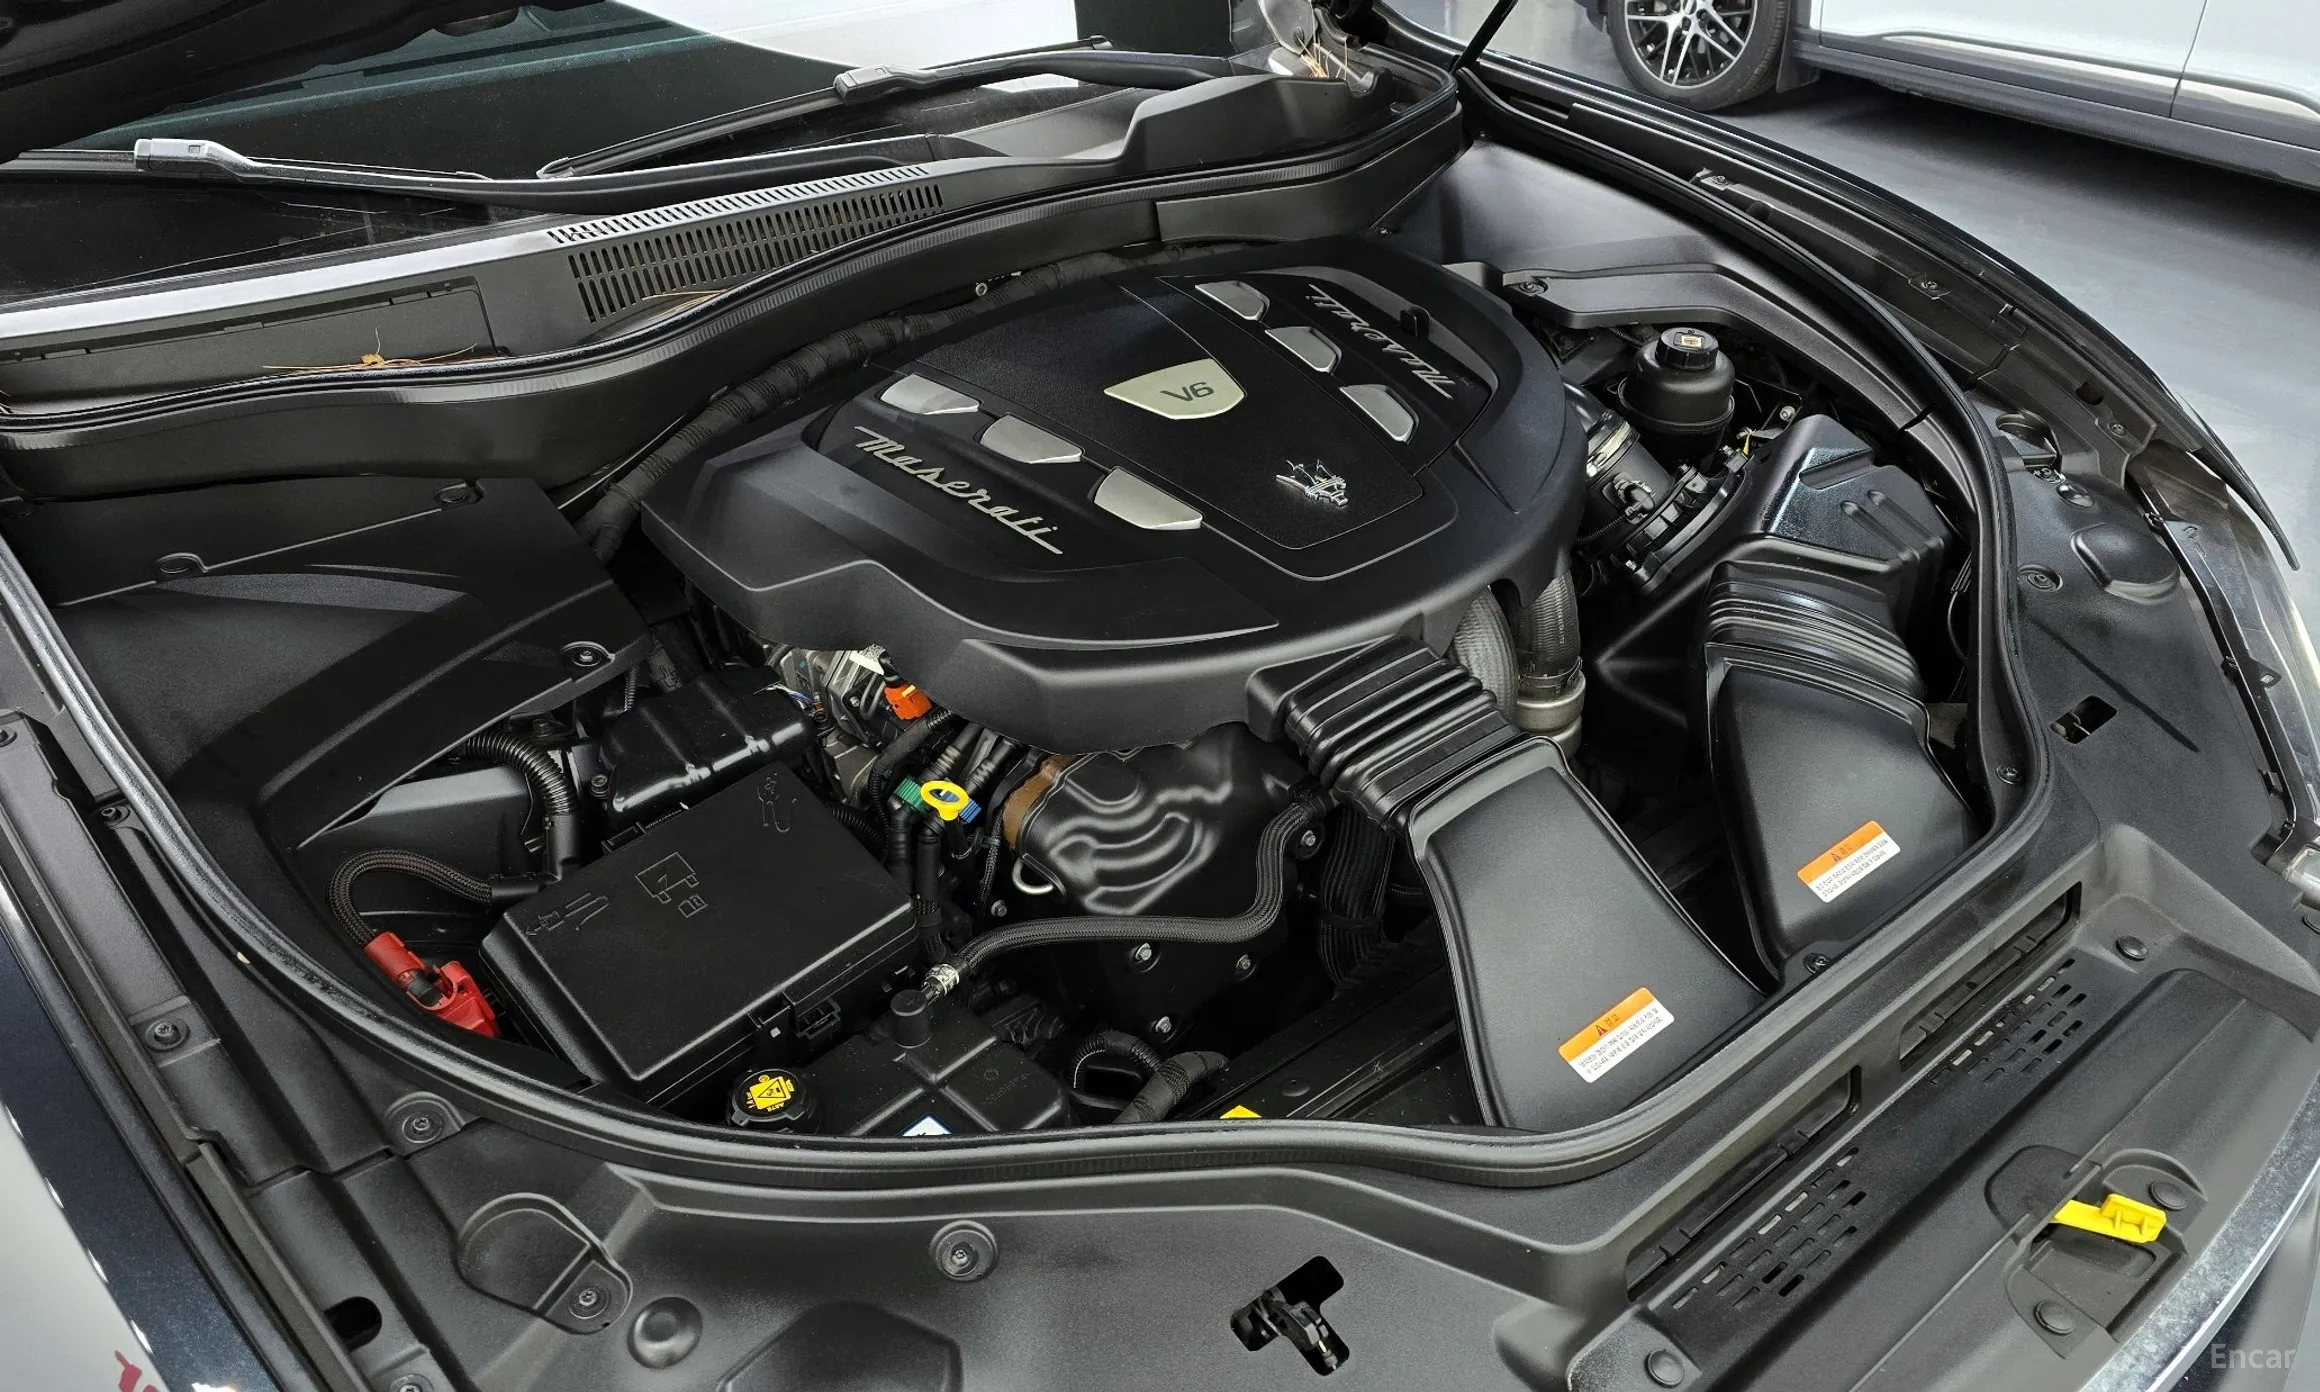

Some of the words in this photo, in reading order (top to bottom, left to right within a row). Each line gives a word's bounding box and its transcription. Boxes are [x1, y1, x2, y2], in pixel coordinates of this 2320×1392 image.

[1160, 382, 1214, 402] V6
[1305, 284, 1455, 400] Maserati
[854, 426, 1063, 555] Maserati
